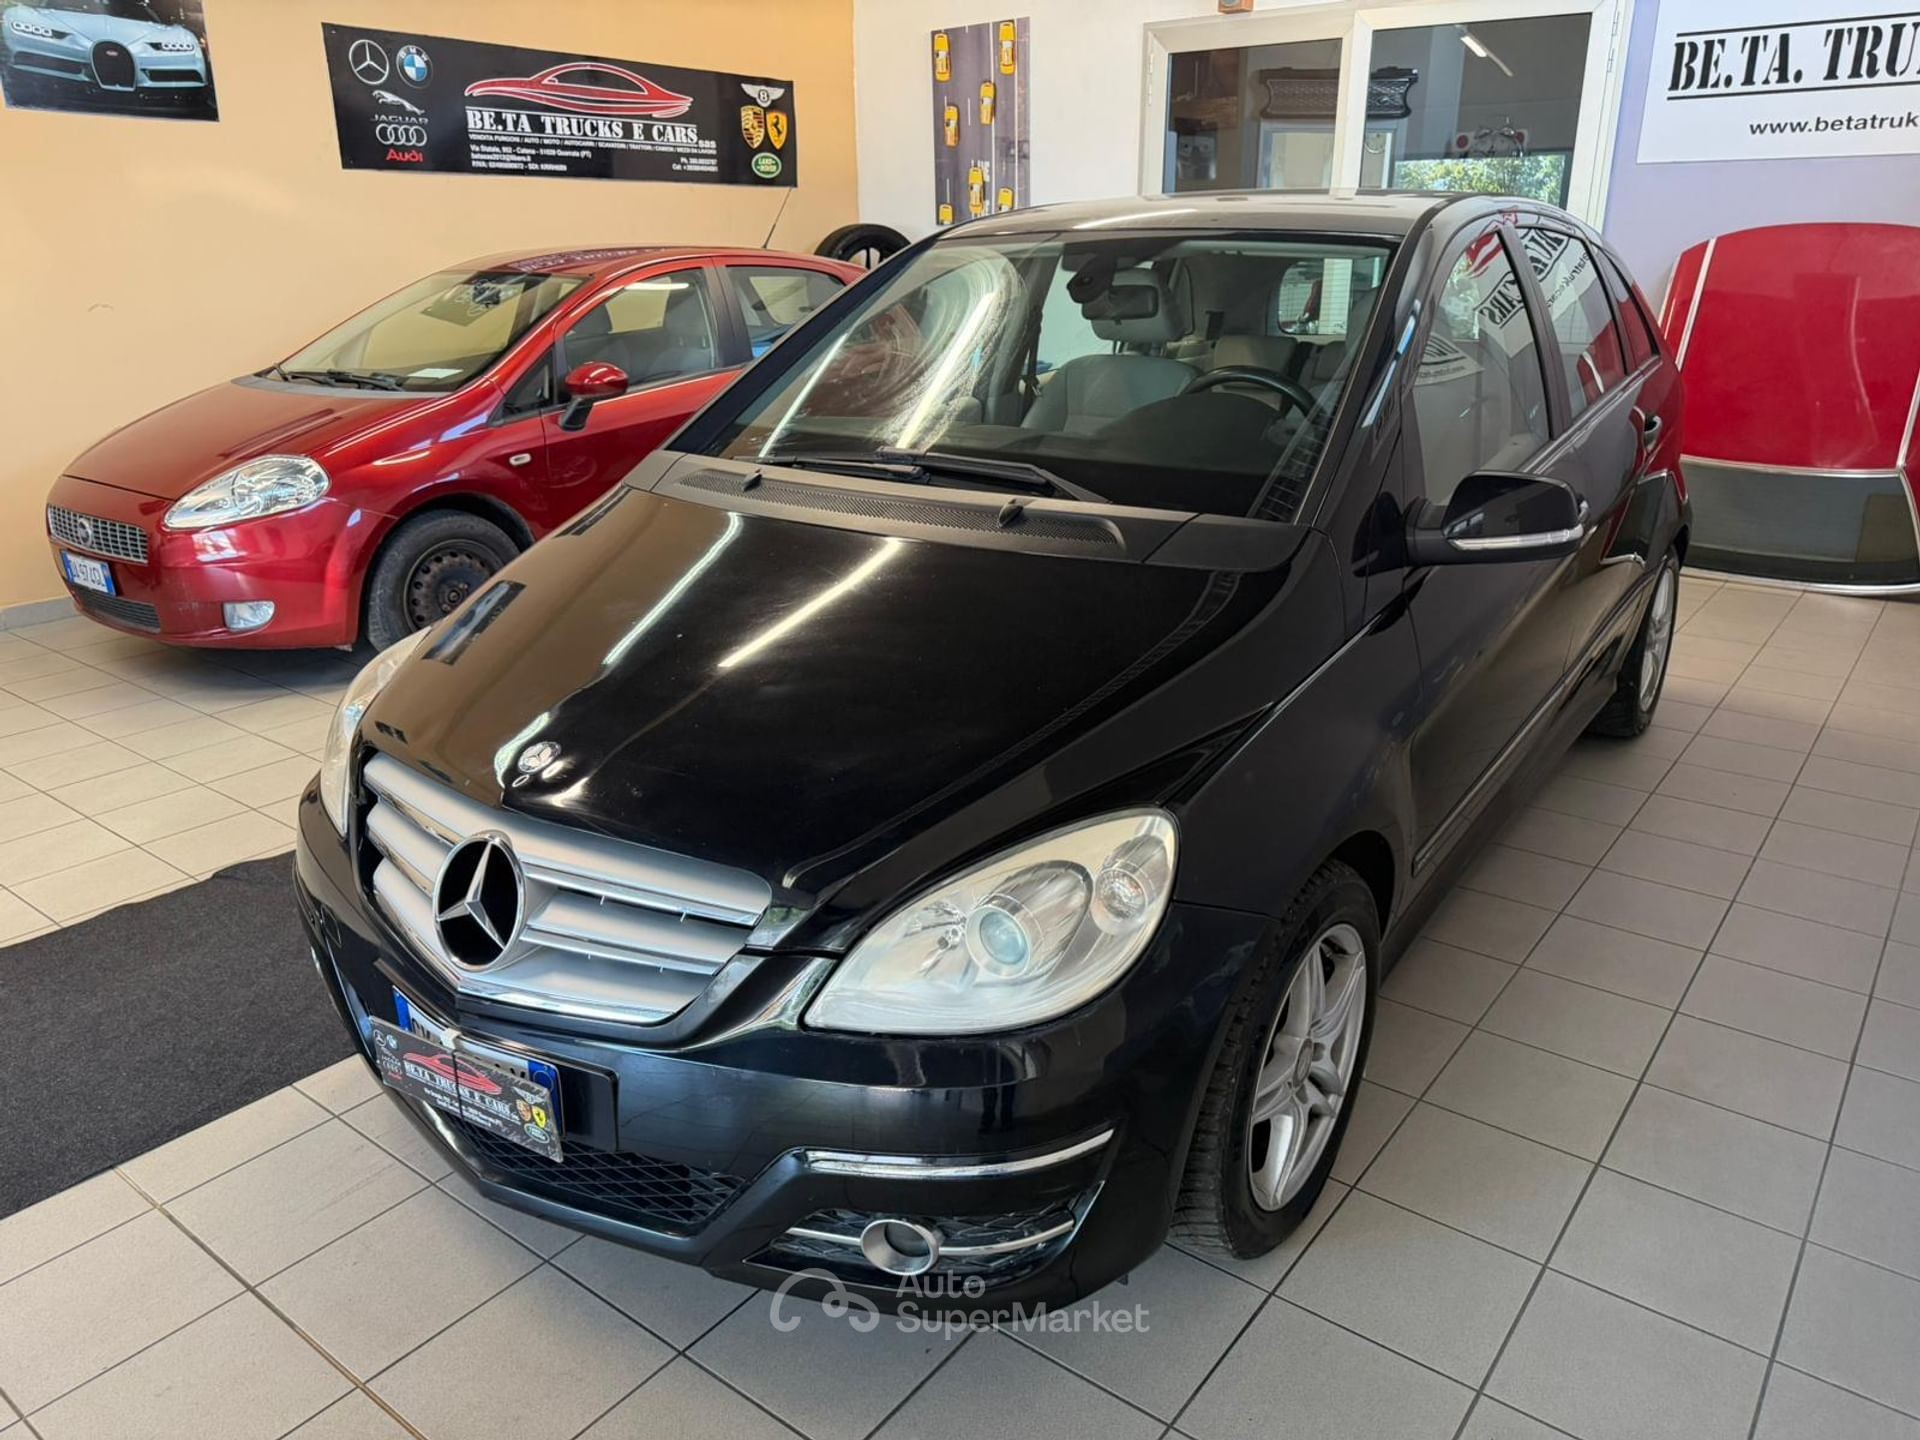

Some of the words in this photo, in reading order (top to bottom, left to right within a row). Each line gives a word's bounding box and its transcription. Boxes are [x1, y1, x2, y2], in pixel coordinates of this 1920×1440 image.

[1668, 33, 1803, 91] BE.TA.
[1823, 22, 1920, 81] TRU
[371, 114, 429, 124] JAGUAR
[466, 110, 532, 132] BE.TA
[541, 115, 624, 138] TRUCKS
[632, 123, 644, 140] E
[652, 125, 698, 144] CARS
[386, 148, 424, 162] Audi
